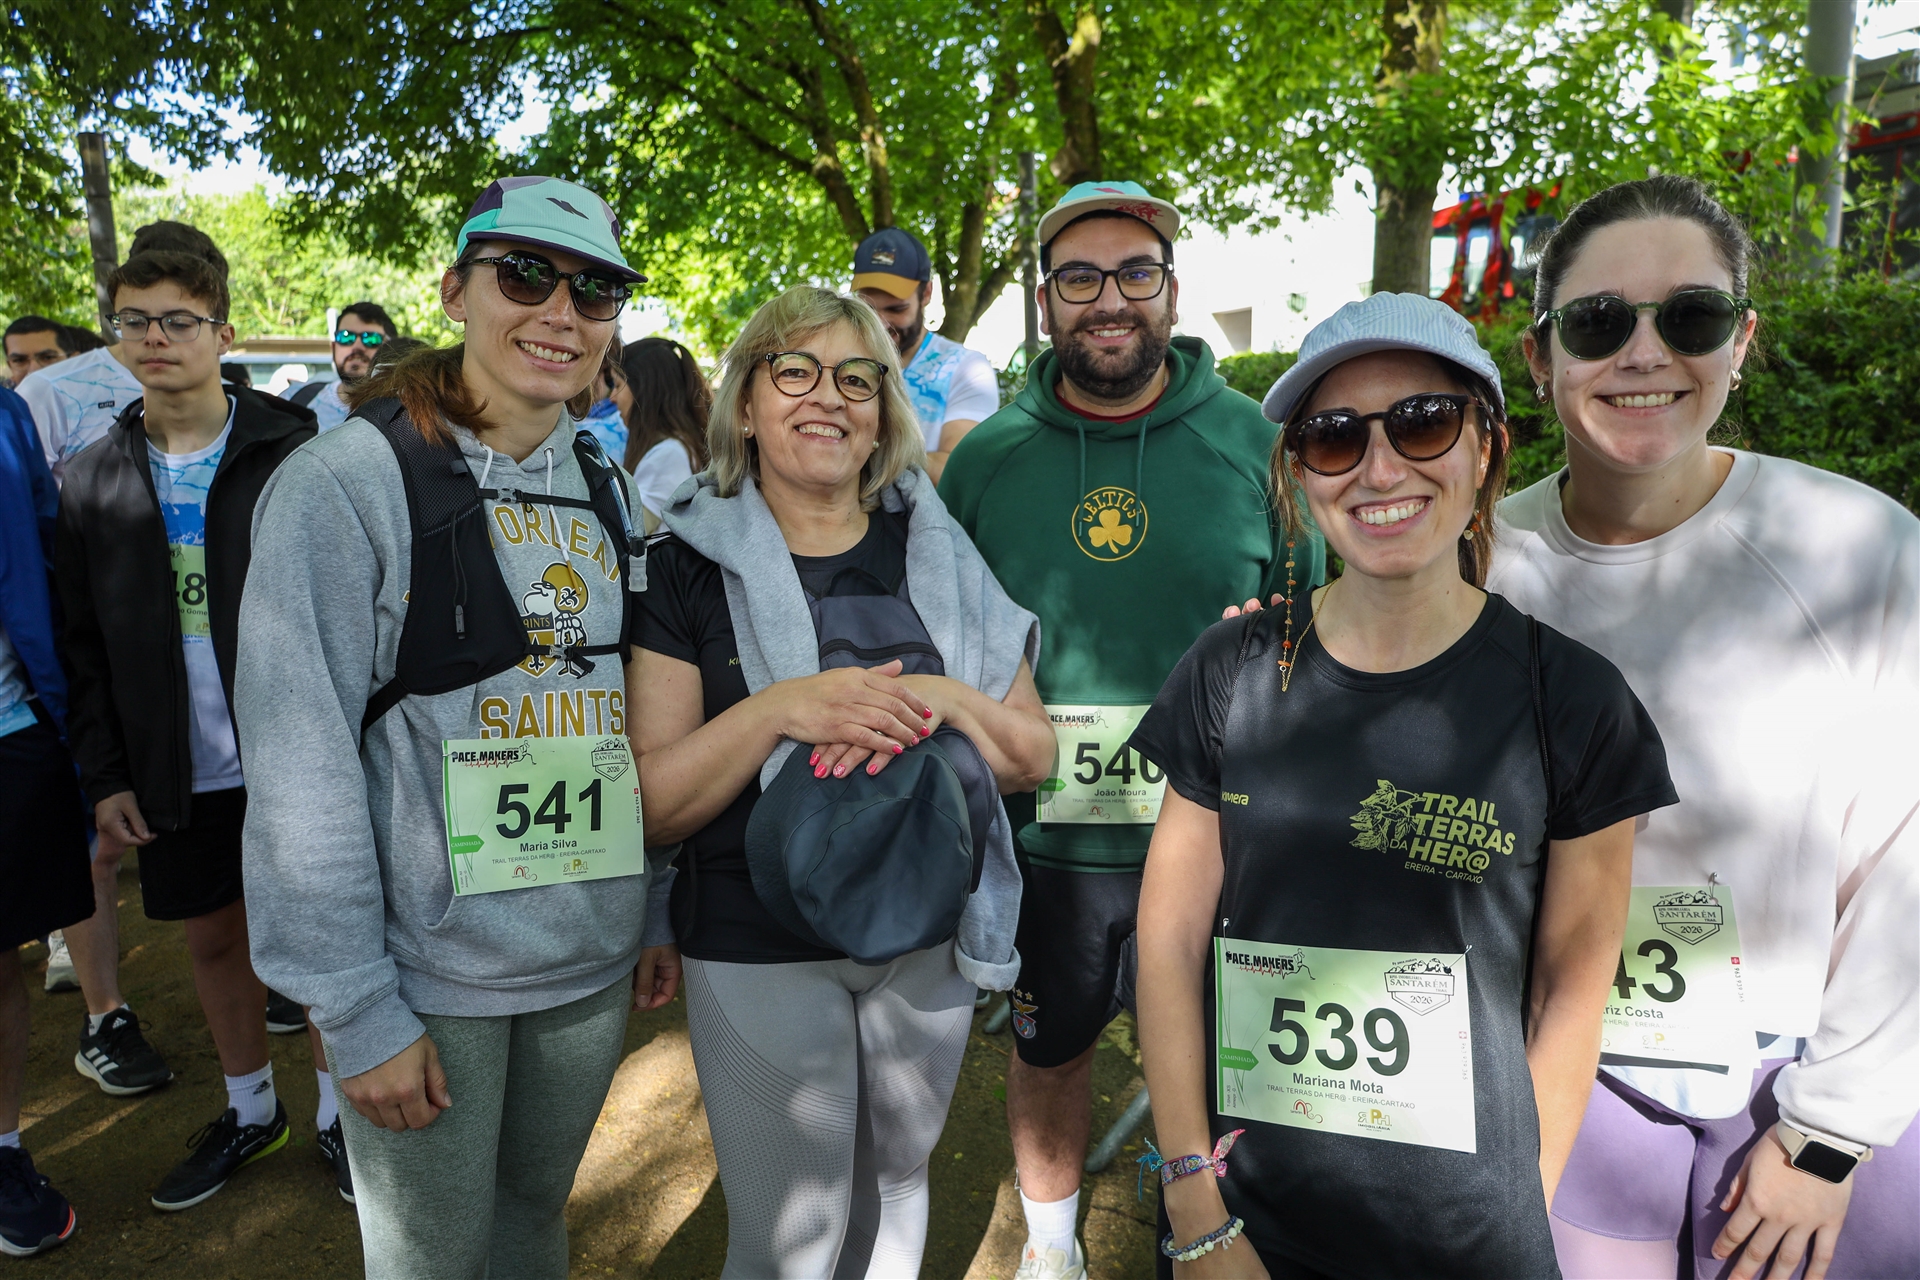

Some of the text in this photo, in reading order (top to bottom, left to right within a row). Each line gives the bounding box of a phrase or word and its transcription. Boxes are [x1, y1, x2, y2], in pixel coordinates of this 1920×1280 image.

[172, 570, 206, 606] 8
[186, 608, 208, 616] Gome
[522, 617, 551, 628] AINTS
[479, 689, 625, 740] SAINTS
[1048, 714, 1095, 723] ACE.MAKERS
[594, 753, 627, 762] SANTARÉM
[1073, 742, 1165, 785] 540
[1094, 788, 1147, 797] João Moura
[496, 778, 602, 839] 541
[1422, 791, 1500, 826] TRAIL
[1415, 813, 1516, 856] TERRAS
[450, 840, 482, 848] CAMINHADA
[520, 839, 578, 853] Maria Silva
[1389, 837, 1491, 874] DA HER@
[1404, 861, 1436, 875] EREIRA
[1445, 870, 1484, 884] CARTAXO
[1659, 909, 1717, 919] SANTARÉM
[1680, 925, 1703, 934] 2026
[1225, 951, 1295, 971] PACE.MAKERS
[1612, 938, 1687, 1004] 43
[1389, 978, 1448, 989] SANTARÉM
[1410, 995, 1433, 1005] 2026
[1603, 1004, 1664, 1019] riz Costa
[1268, 997, 1410, 1077] 539
[1219, 1053, 1255, 1064] CAMINHADA
[1293, 1072, 1384, 1094] Mariana Mota
[1266, 1084, 1284, 1093] TRAIL
[1286, 1087, 1313, 1097] TERRAS
[1325, 1093, 1347, 1102] HER@
[1352, 1096, 1416, 1110] EREIRA-CARTAXO
